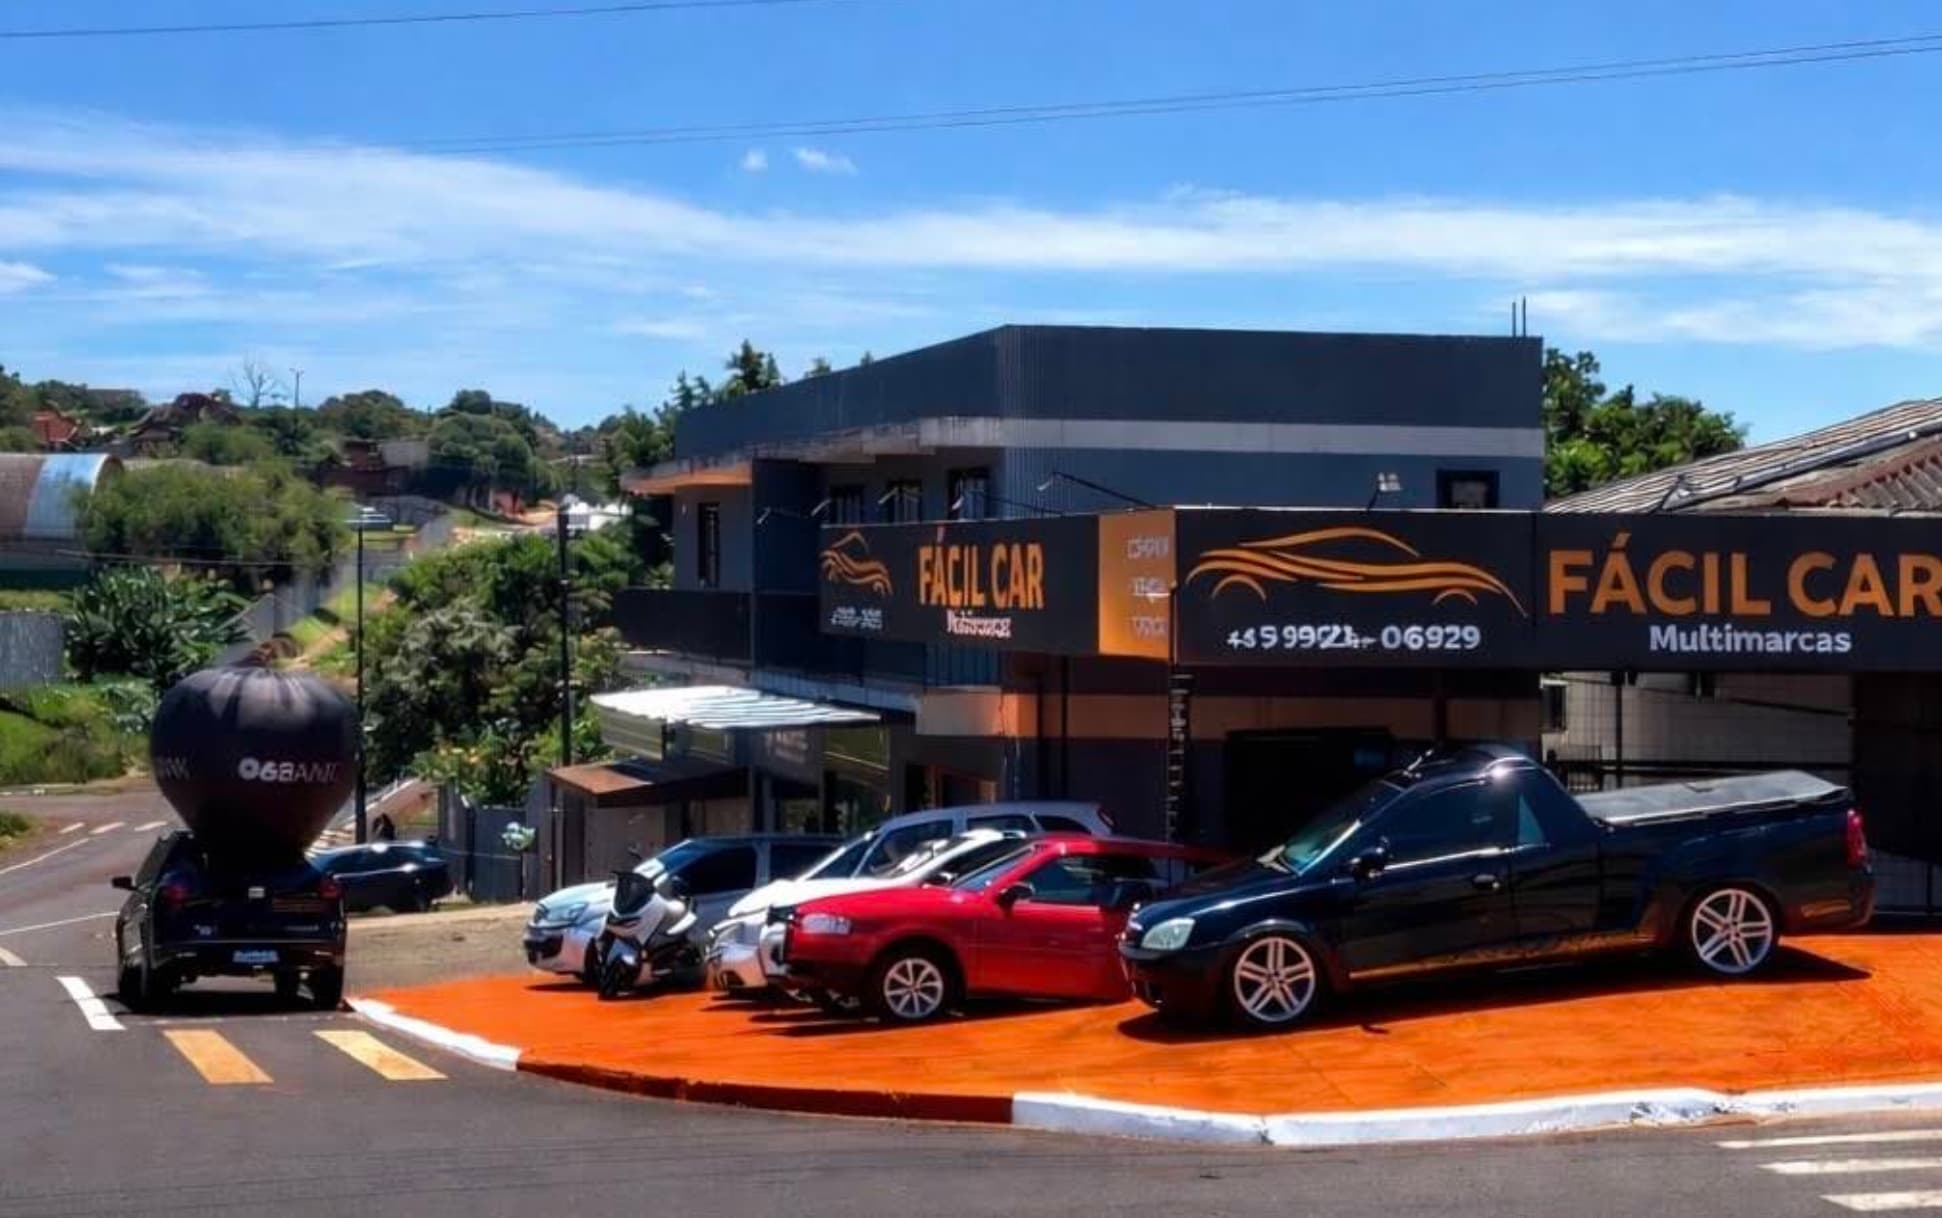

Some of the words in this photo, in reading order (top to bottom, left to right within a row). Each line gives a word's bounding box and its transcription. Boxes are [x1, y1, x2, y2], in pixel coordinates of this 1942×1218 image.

[918, 525, 985, 609] FÁCIL
[990, 541, 1045, 610] CAR
[1549, 531, 1771, 616] FÁCIL
[1787, 550, 1942, 618] CAR
[1381, 624, 1481, 650] 06929
[1649, 624, 1852, 653] Multimarcas
